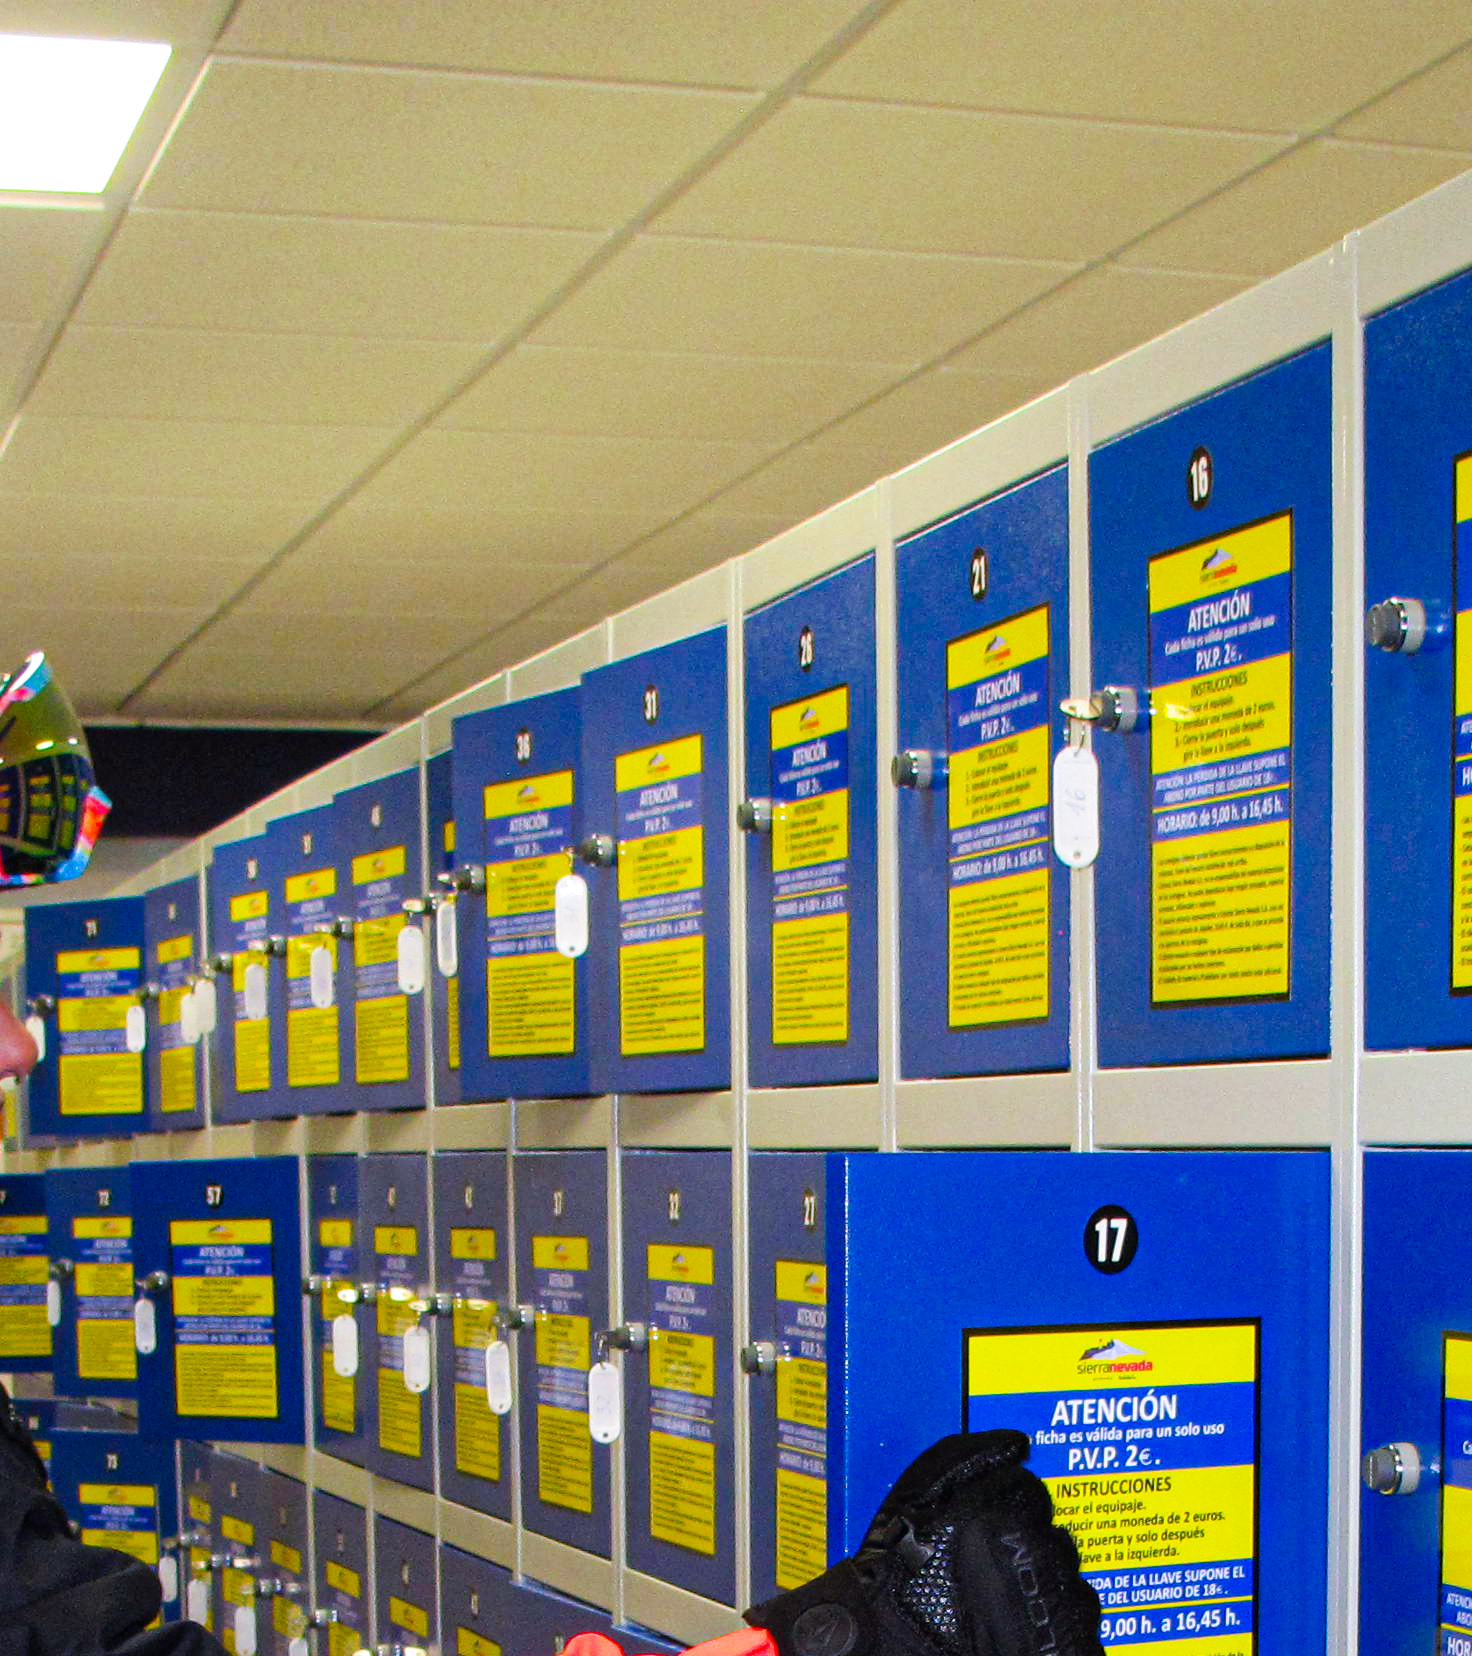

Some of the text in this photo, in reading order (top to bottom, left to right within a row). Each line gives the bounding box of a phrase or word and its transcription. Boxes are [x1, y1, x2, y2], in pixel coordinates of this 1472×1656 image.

[1191, 457, 1208, 501] 16
[973, 556, 985, 594] 21
[1188, 588, 1250, 634] ATENCIÓN
[1095, 1218, 1127, 1261] 17
[1051, 1388, 1177, 1427] ATENCIÓN
[1057, 1476, 1172, 1500] INSTRUCCIONES
[1177, 1609, 1222, 1632] 16,45
